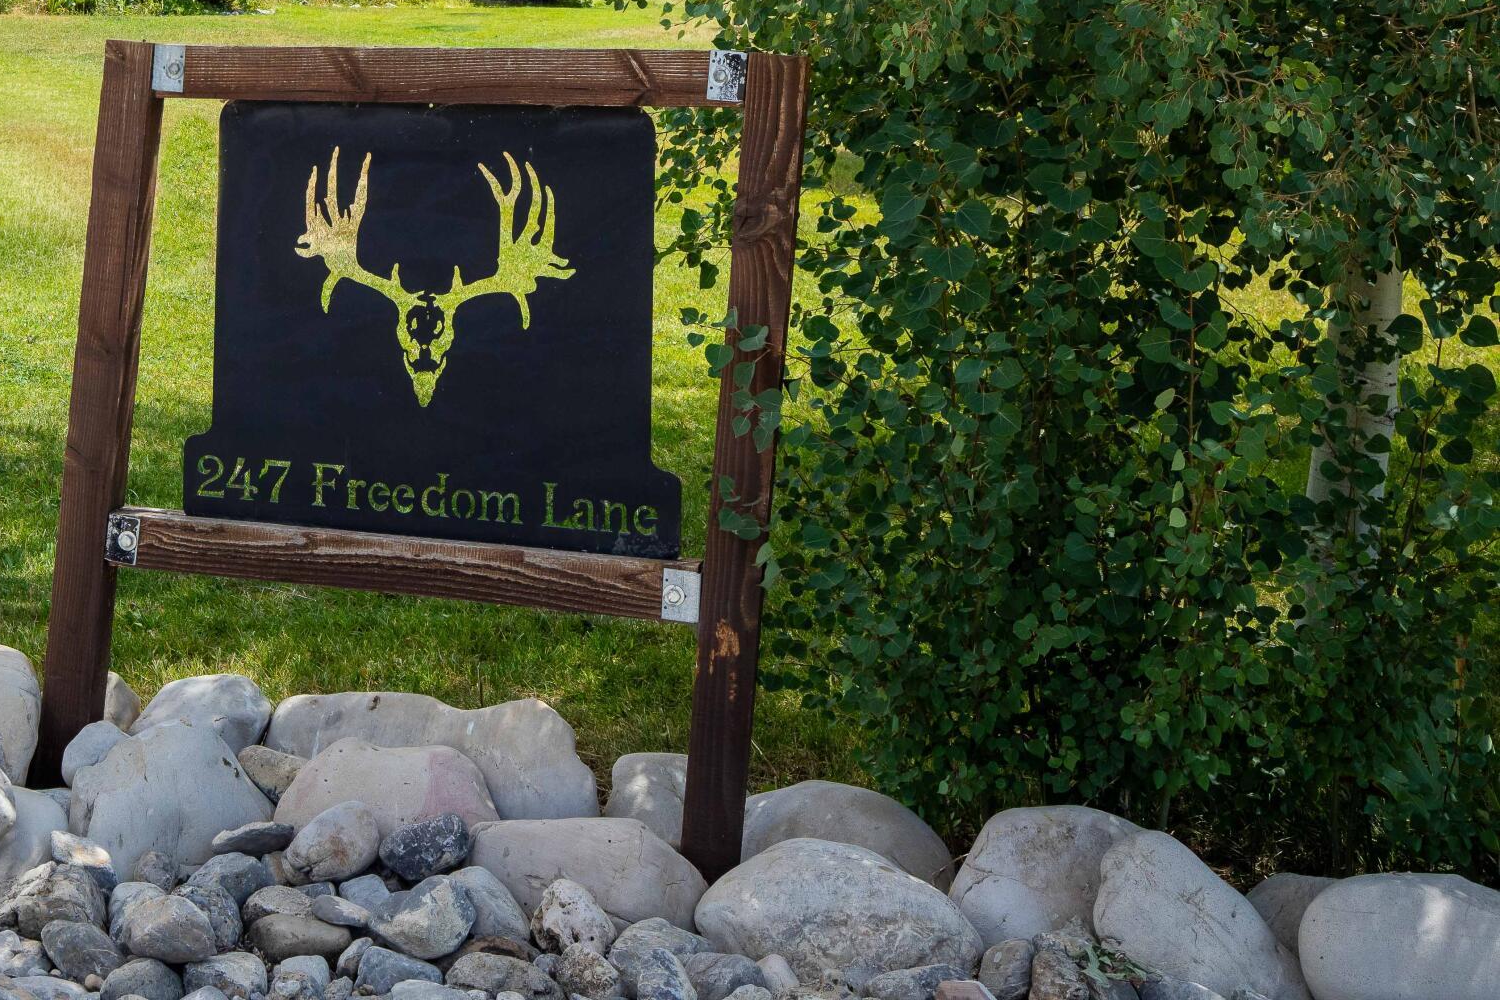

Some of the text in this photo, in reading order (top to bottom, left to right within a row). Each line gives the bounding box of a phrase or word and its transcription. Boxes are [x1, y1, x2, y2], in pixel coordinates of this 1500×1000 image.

[196, 454, 659, 537] 247 Freedom Lane
